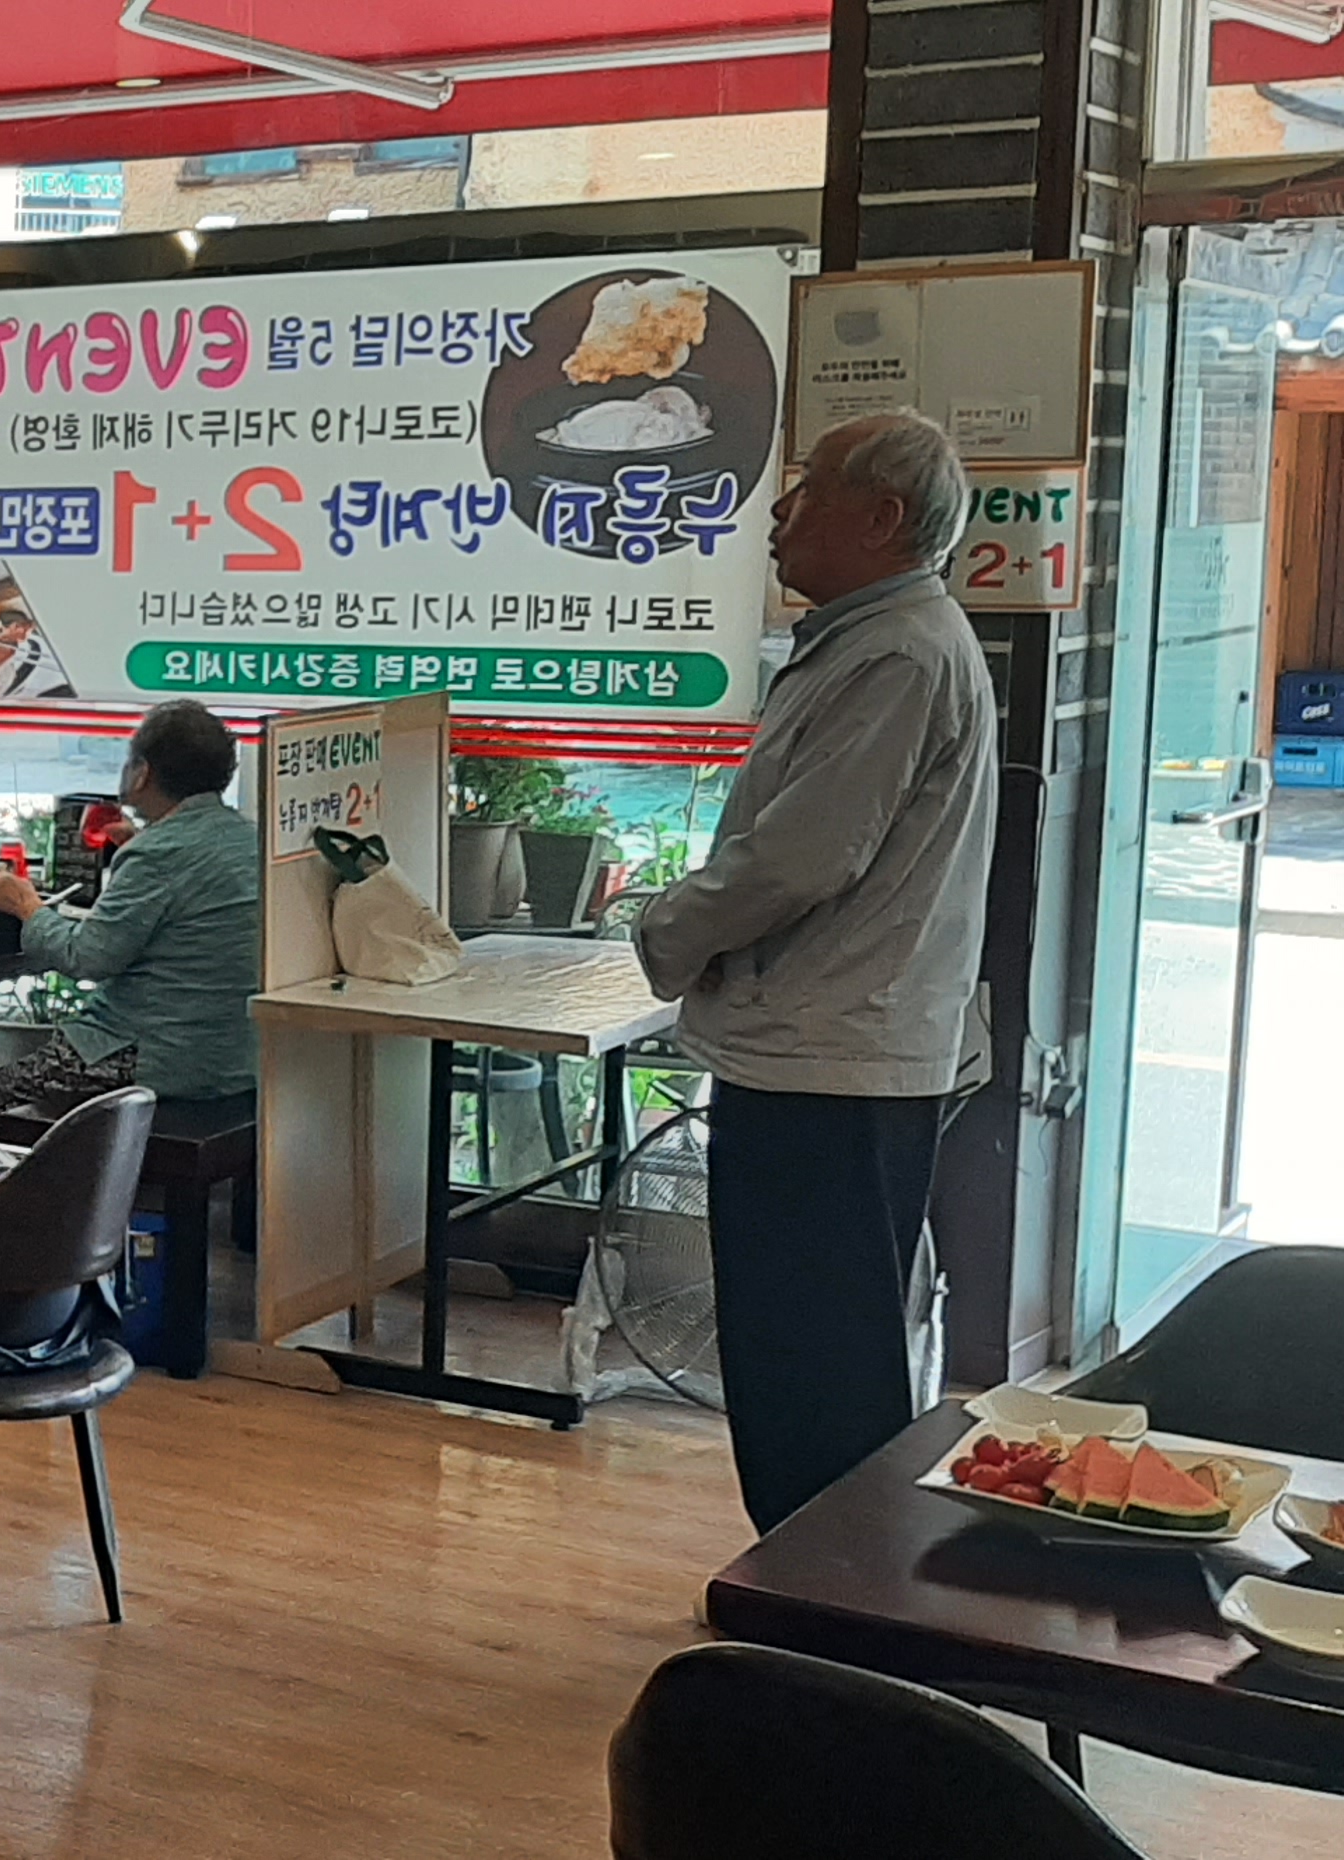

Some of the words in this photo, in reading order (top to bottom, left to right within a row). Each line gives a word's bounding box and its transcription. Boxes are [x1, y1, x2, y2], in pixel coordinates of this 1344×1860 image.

[966, 540, 1069, 589] 2+1
[277, 741, 302, 777] 포장
[329, 729, 382, 769] EVENT
[345, 778, 383, 826] 2+1
